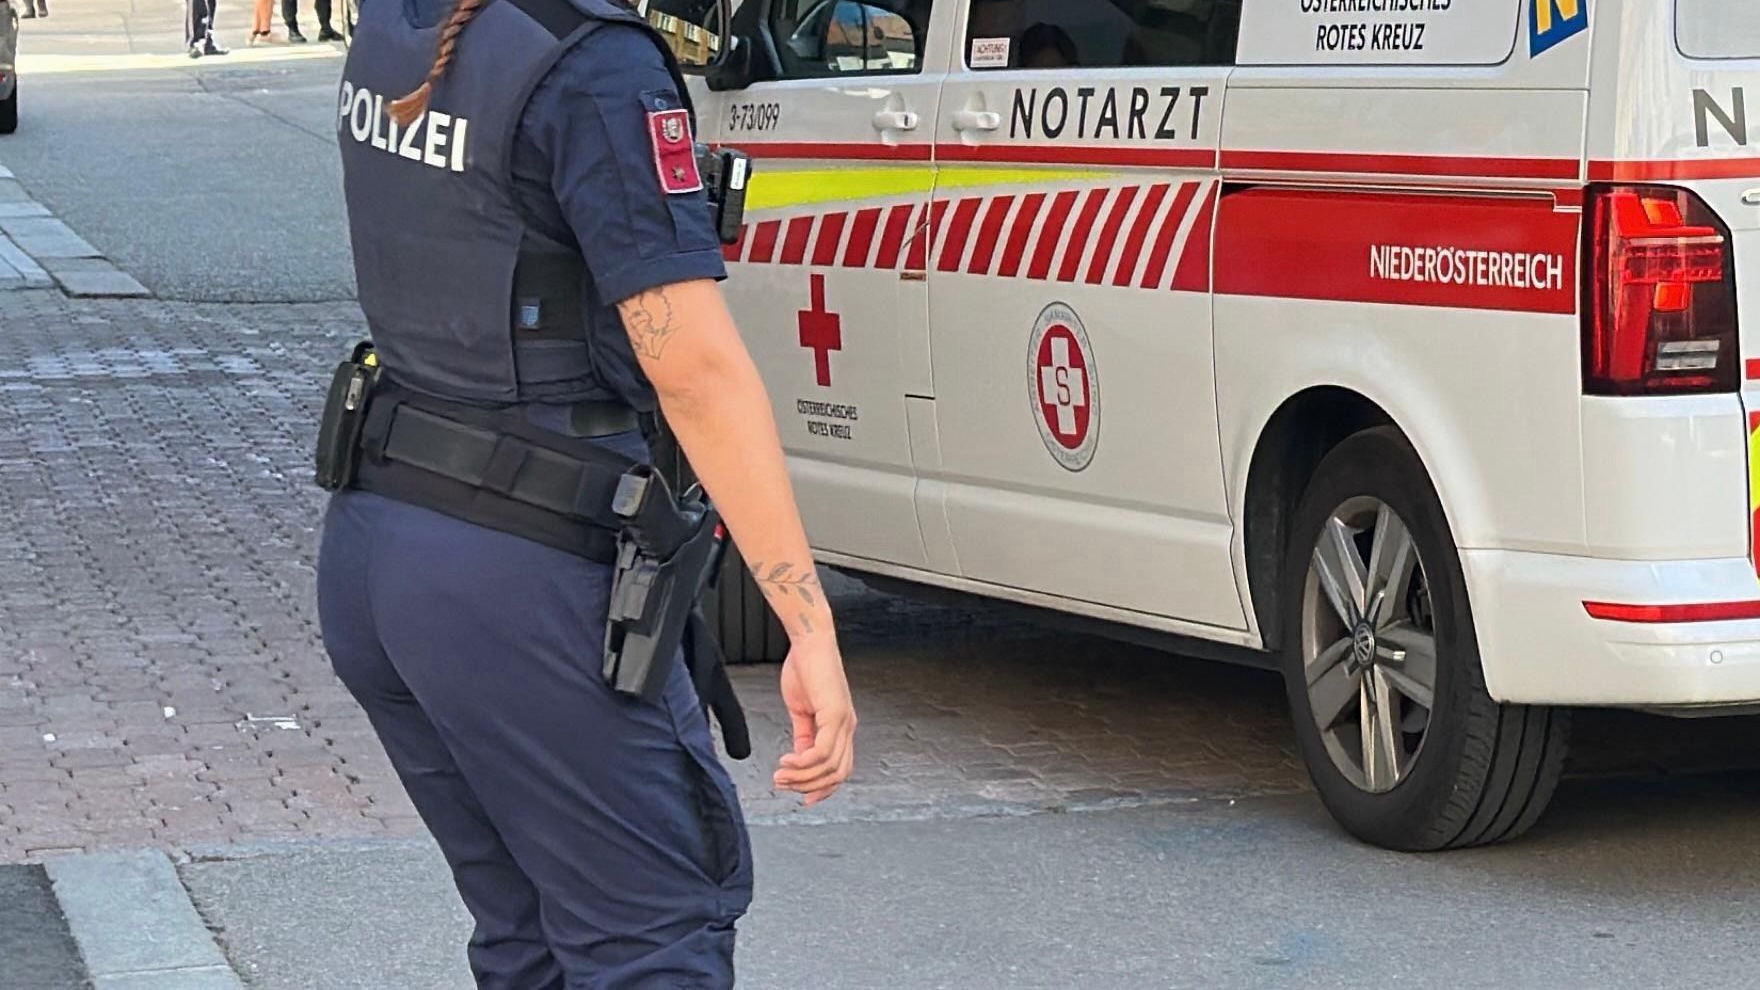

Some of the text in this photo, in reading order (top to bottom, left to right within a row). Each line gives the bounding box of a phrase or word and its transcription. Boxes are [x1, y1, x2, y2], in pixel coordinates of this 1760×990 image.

[1316, 23, 1426, 51] ROTES KREUZ
[338, 80, 468, 172] POLIZEI
[1009, 86, 1209, 140] NOTARZT
[1369, 244, 1563, 290] NIEDERÖSTERREICH
[1055, 366, 1070, 406] S
